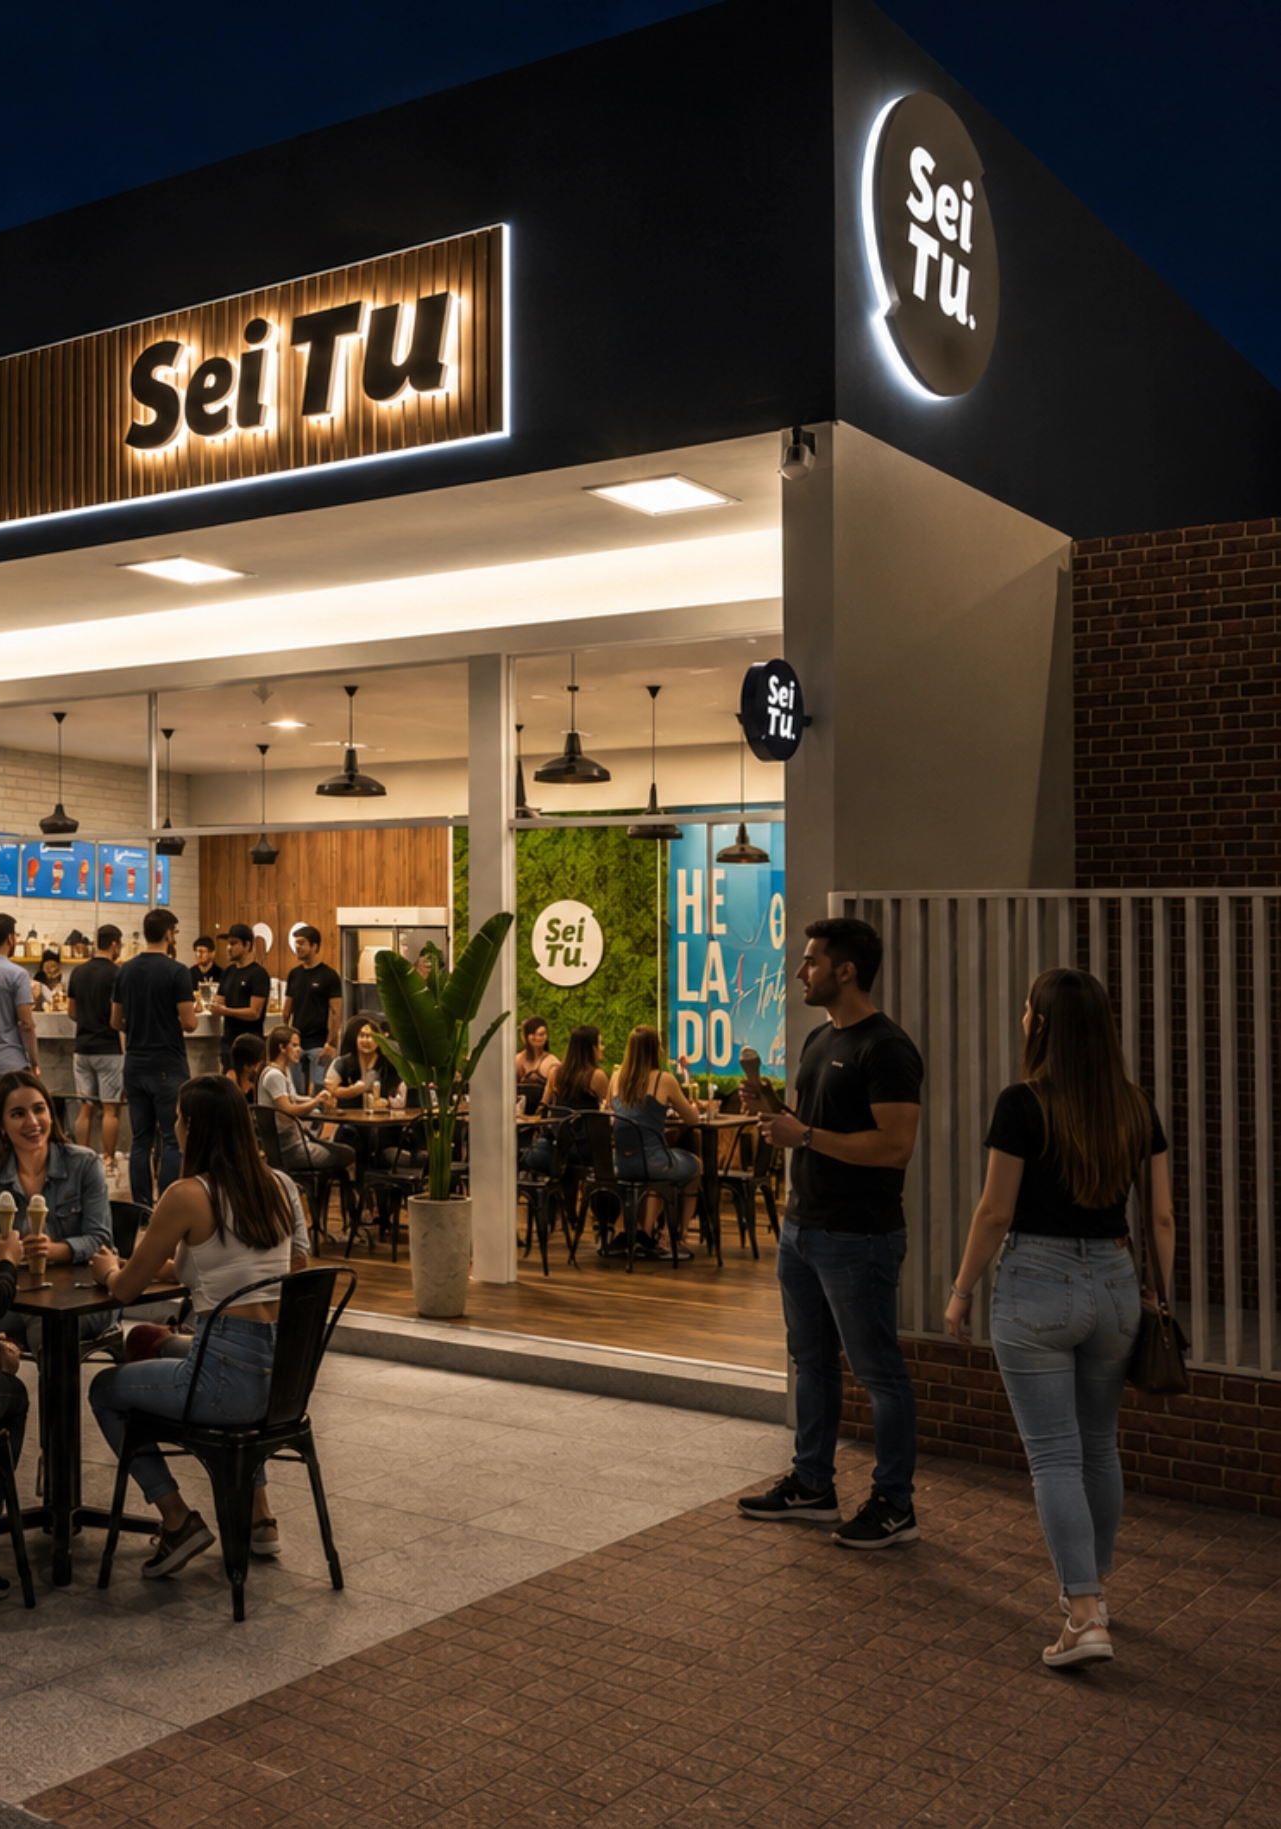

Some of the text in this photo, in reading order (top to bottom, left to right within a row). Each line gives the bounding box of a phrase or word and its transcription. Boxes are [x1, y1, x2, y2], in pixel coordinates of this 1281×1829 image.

[907, 146, 973, 253] Sei
[125, 318, 270, 449] Sei
[767, 675, 795, 709] Sei
[545, 917, 586, 943] Sei
[677, 869, 727, 934] HE
[677, 941, 730, 1003] LA
[677, 1009, 732, 1070] DO
